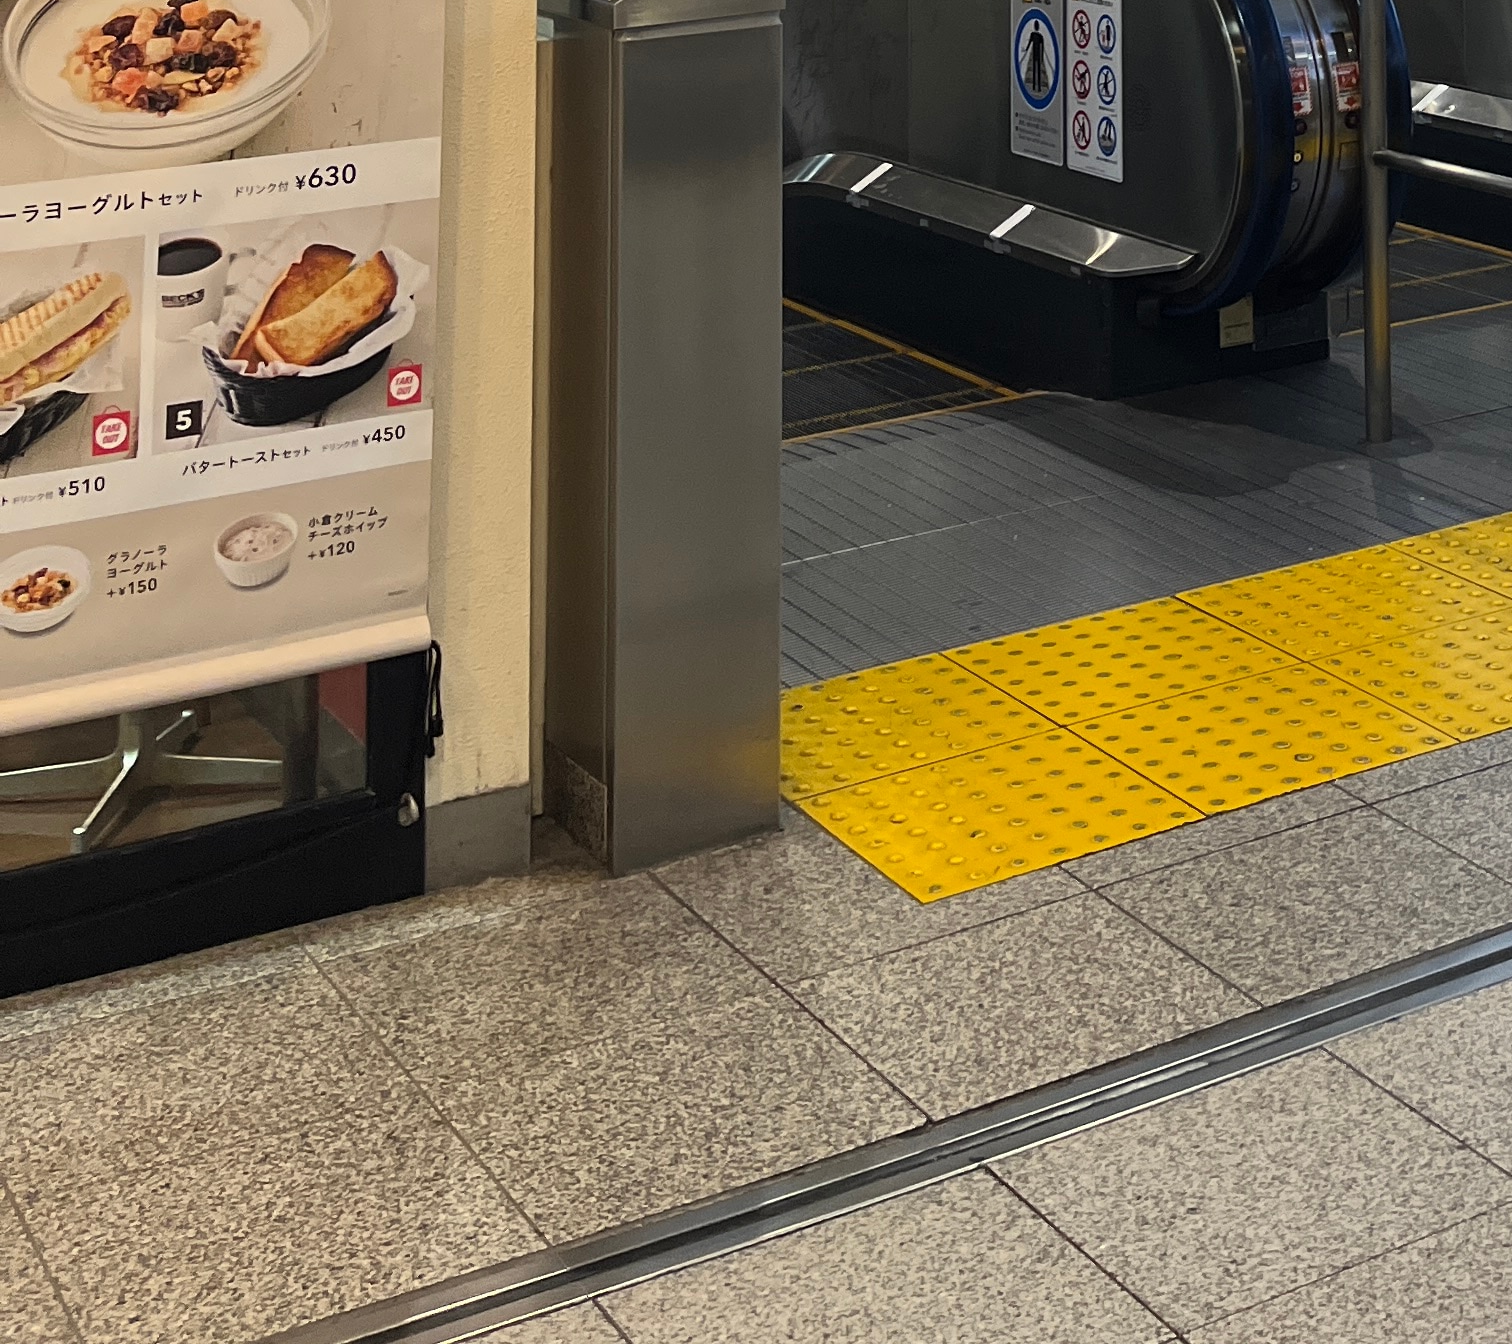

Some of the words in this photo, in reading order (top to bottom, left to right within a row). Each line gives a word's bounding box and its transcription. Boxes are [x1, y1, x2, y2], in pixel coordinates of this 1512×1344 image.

[235, 180, 290, 199] ドリンク付
[295, 163, 357, 190] ¥630
[175, 409, 192, 431] 5
[182, 445, 311, 477] バタートーストセット
[363, 424, 406, 445] ¥450
[59, 476, 105, 498] ¥510
[308, 516, 388, 542] チーズホイップ
[107, 544, 168, 565] グラノーラ
[308, 540, 356, 560] +¥120
[107, 559, 169, 579] ヨーグルト
[107, 577, 158, 598] +¥150
